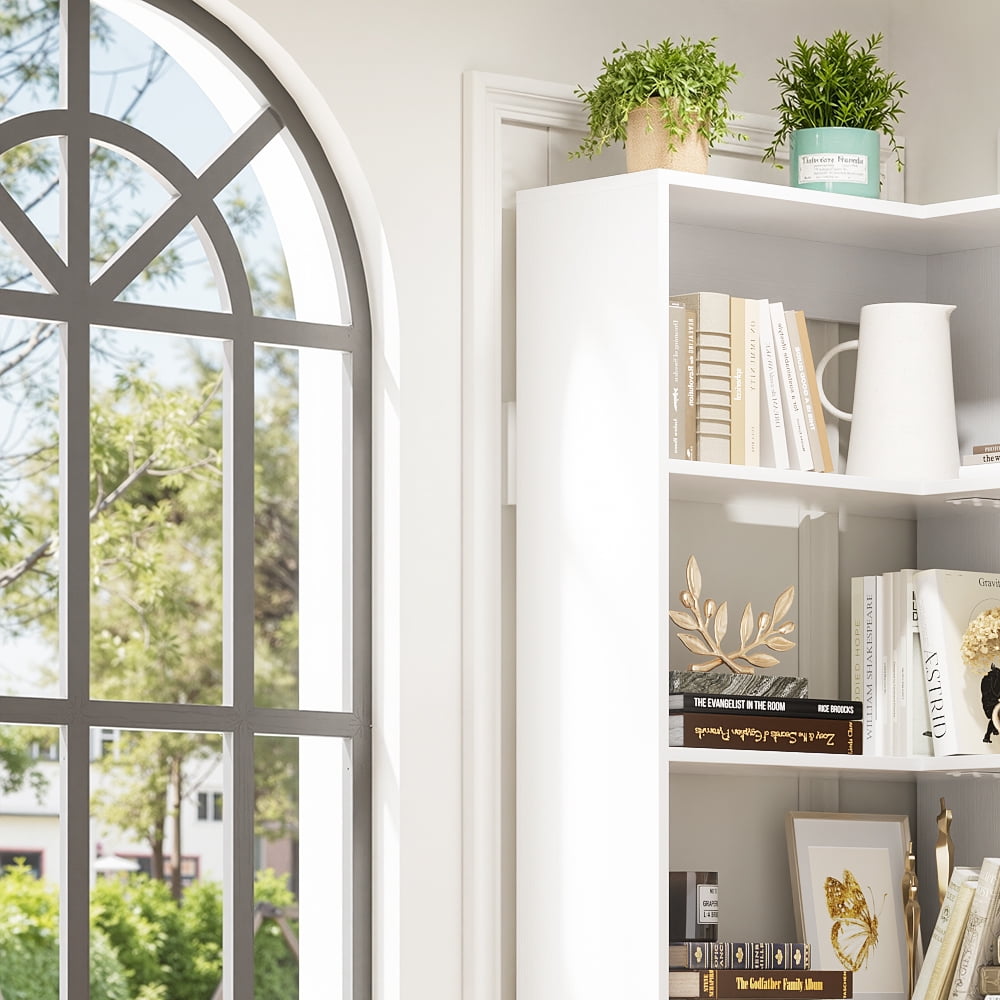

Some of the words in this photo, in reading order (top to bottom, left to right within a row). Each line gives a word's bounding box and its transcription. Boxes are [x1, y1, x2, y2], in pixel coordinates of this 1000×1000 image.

[983, 454, 994, 463] the
[694, 697, 707, 707] THE
[707, 698, 746, 709] EVANGELIST
[746, 700, 753, 709] IN
[753, 700, 767, 710] THE
[767, 701, 786, 712] ROOM
[817, 704, 830, 713] RICE
[830, 705, 854, 714] BROOCKS
[736, 976, 749, 990] The
[749, 976, 781, 990] Godfather
[782, 977, 803, 993] Family
[803, 977, 824, 991] Album
